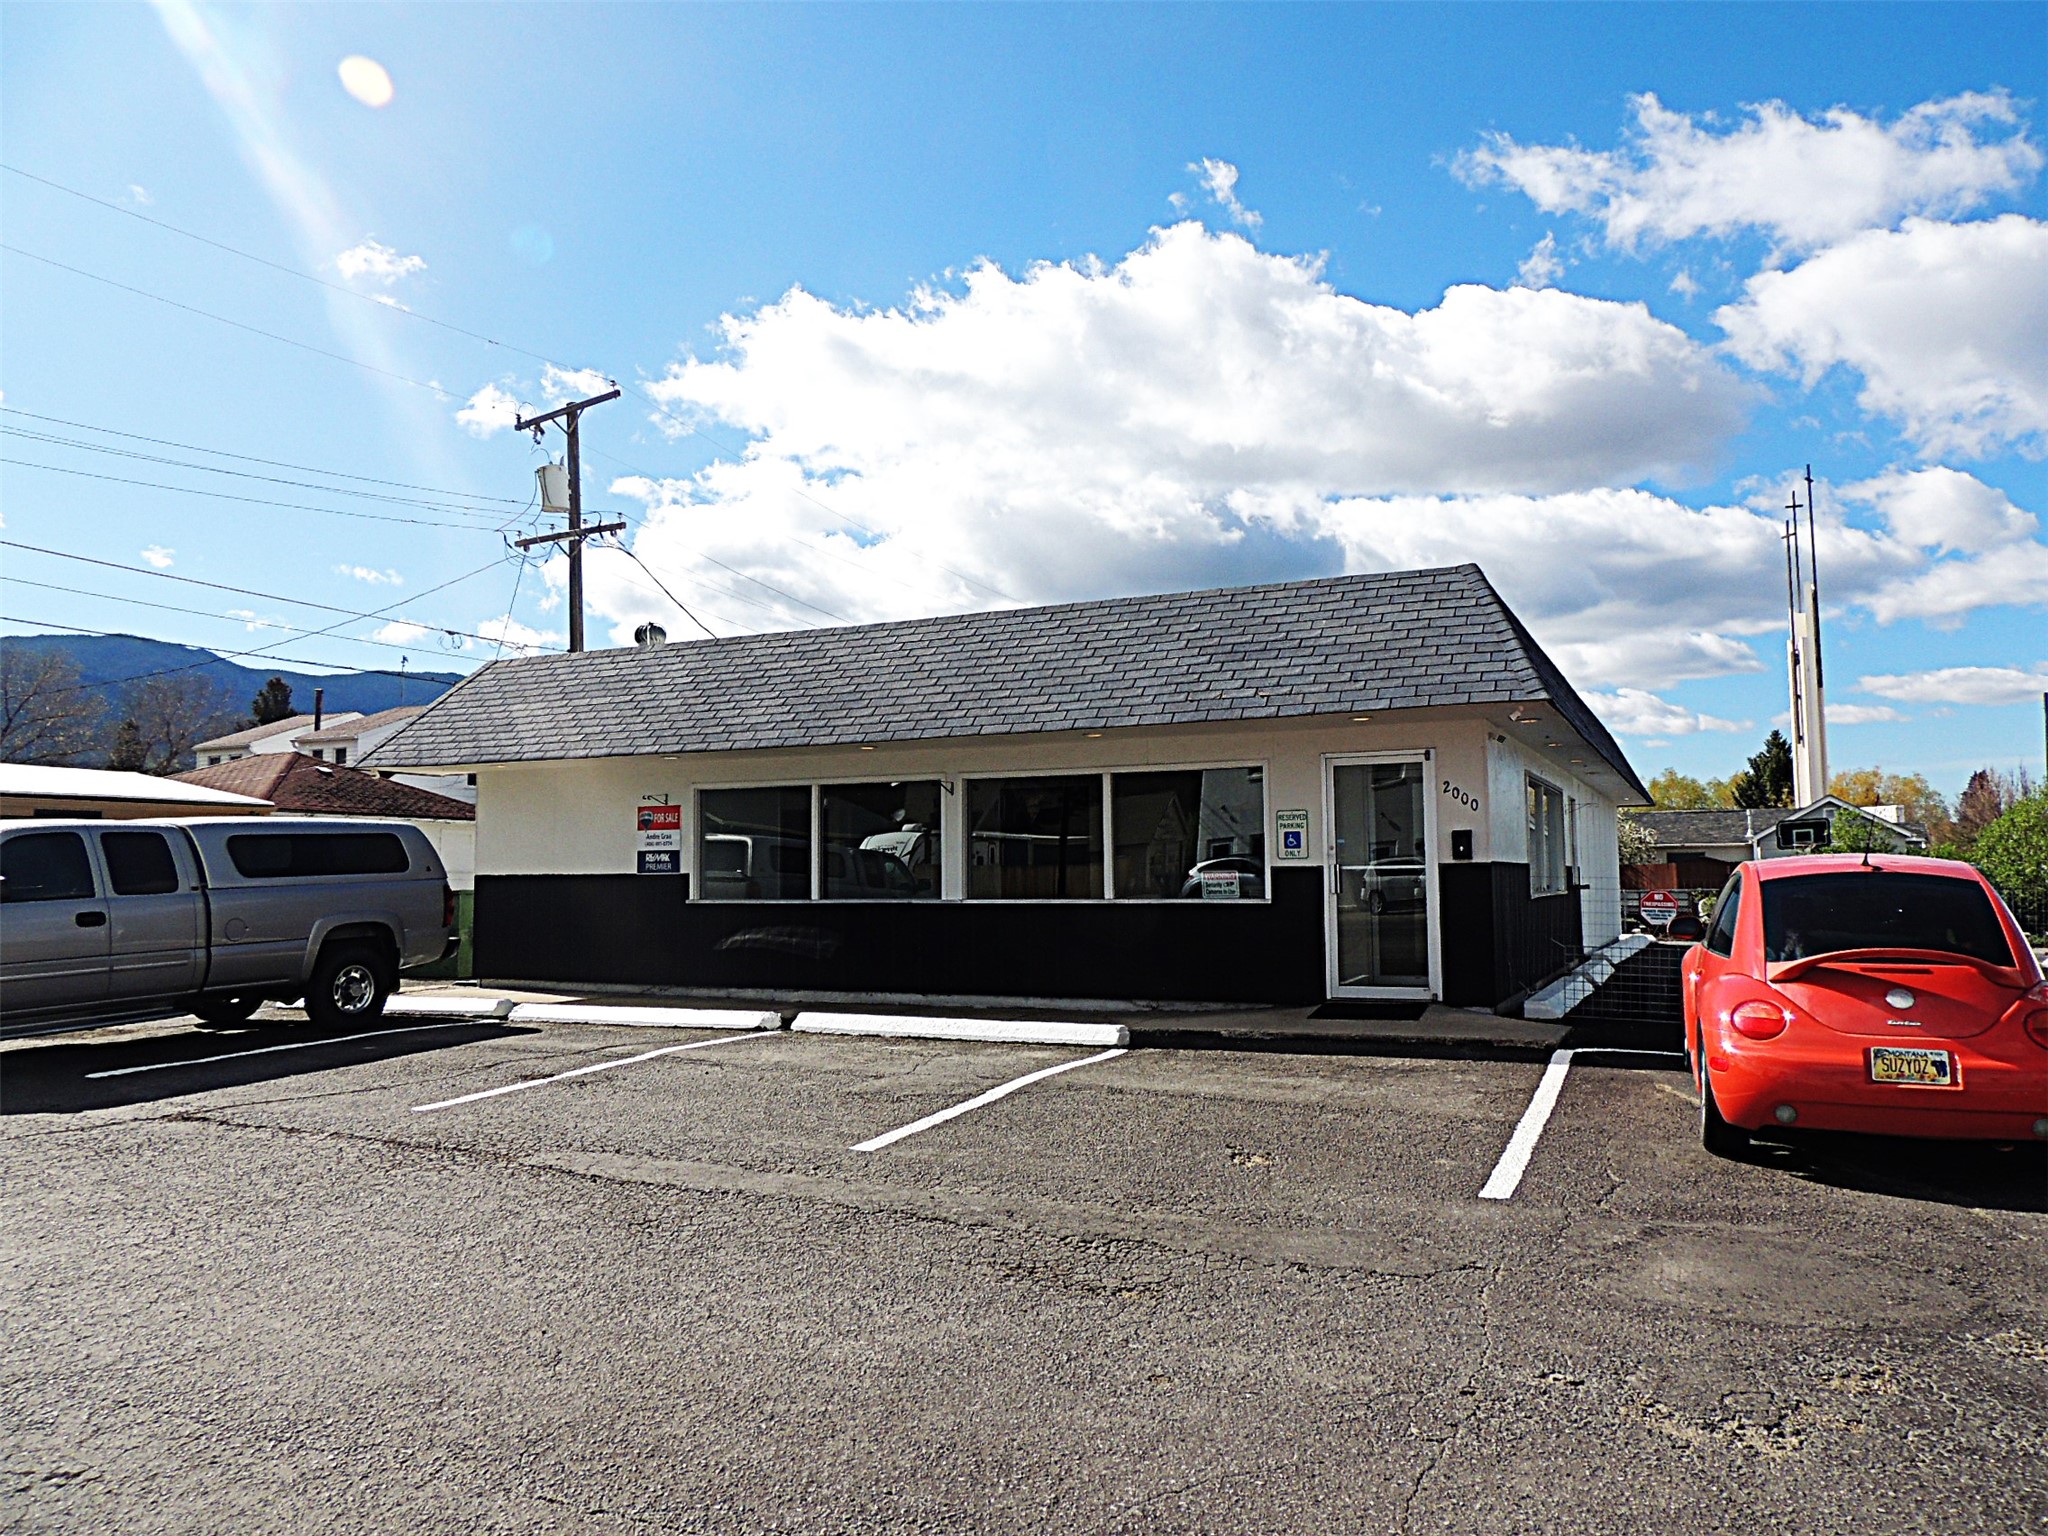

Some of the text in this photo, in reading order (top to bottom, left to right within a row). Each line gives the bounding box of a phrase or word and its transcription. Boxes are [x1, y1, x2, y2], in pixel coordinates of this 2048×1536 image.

[1442, 780, 1479, 812] 2000
[654, 813, 678, 823] FOR SALE
[646, 853, 670, 862] RE/MAX
[646, 863, 671, 871] PREMIER
